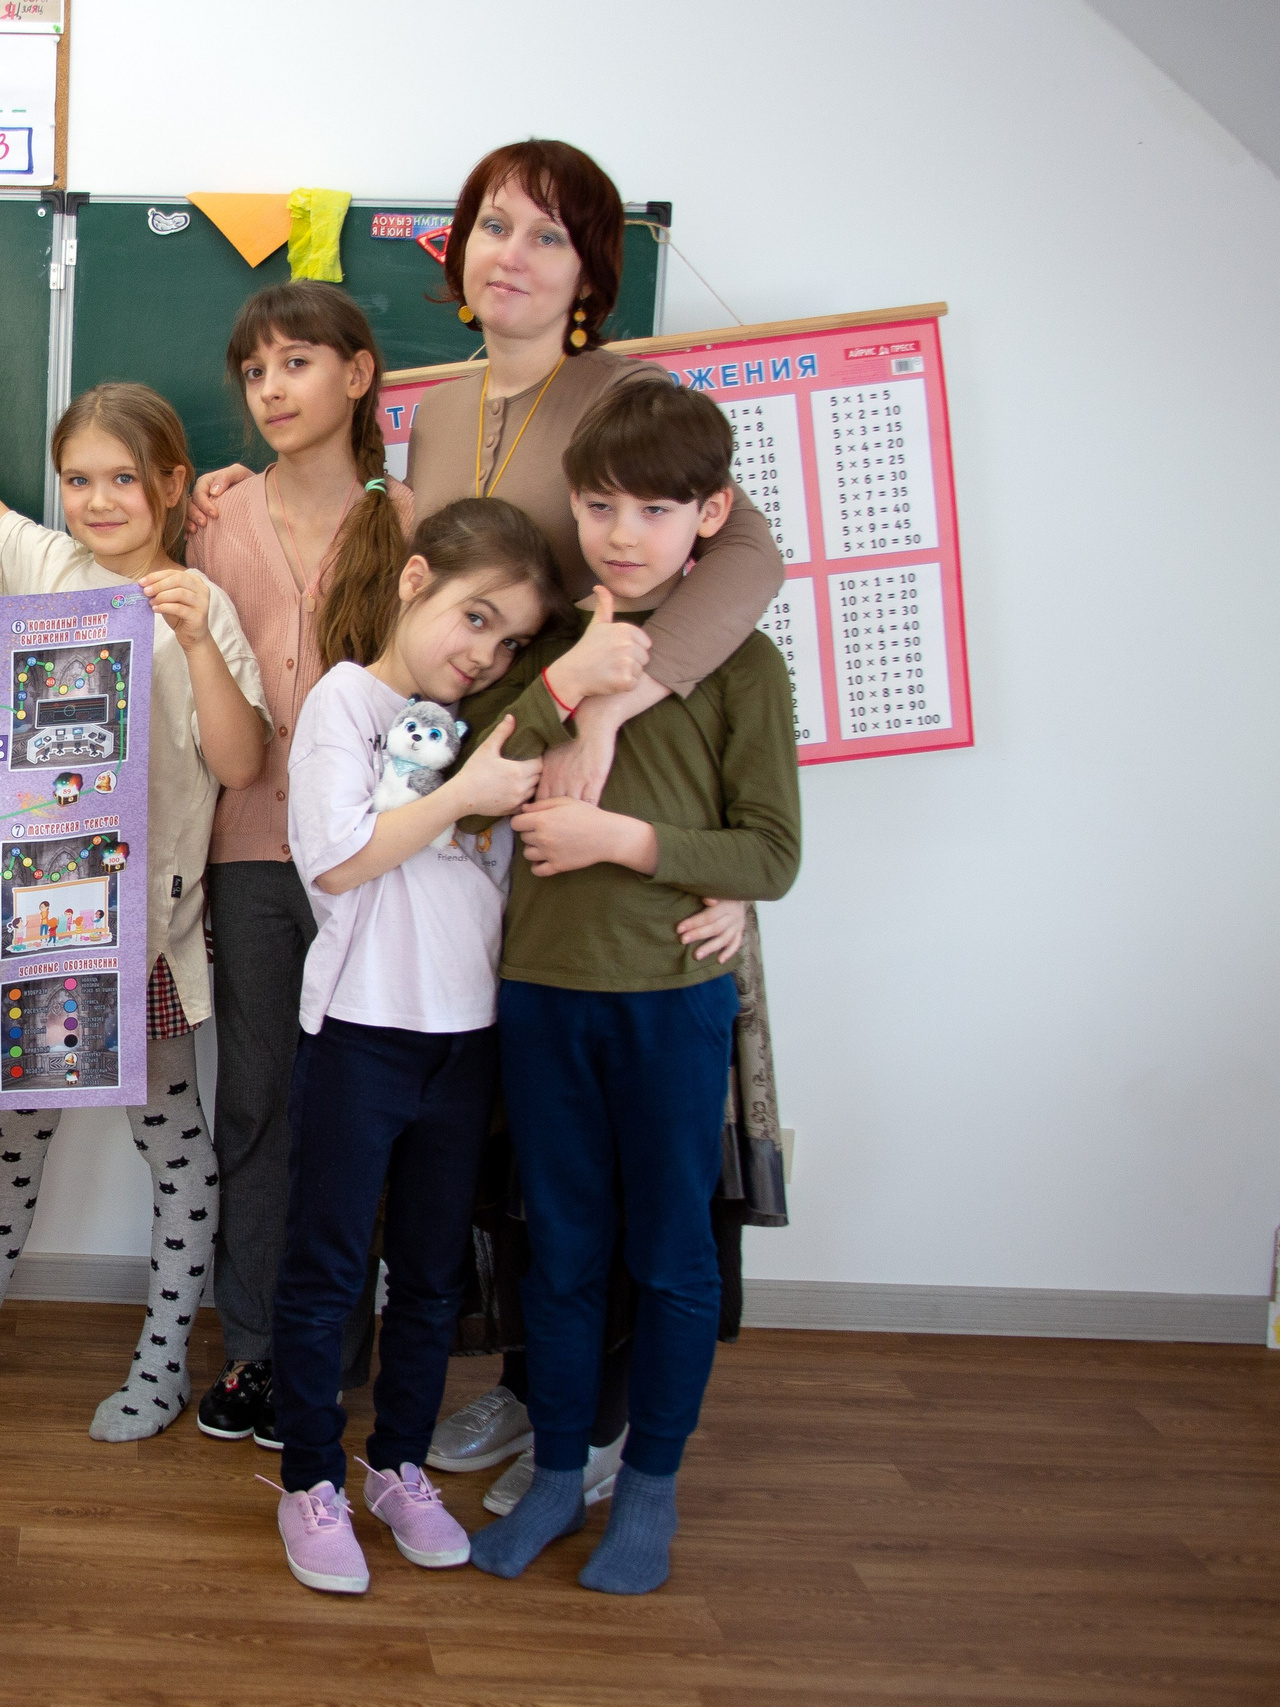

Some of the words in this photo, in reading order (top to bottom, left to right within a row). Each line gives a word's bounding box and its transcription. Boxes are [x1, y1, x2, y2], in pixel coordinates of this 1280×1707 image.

[890, 343, 916, 353] ПРЕСС
[830, 396, 838, 407] 5
[857, 393, 864, 403] 1
[883, 390, 890, 400] 5
[832, 412, 840, 423] 5
[858, 409, 866, 420] 2
[884, 405, 901, 416] 10
[835, 444, 843, 456] 5
[861, 442, 869, 452] 4
[887, 437, 904, 449] 20
[844, 542, 852, 552] 5
[870, 538, 886, 549] 10
[905, 534, 921, 545] 50
[839, 580, 856, 591] 10
[874, 577, 881, 587] 1
[900, 572, 916, 584] 10
[844, 643, 860, 654] 10
[878, 640, 886, 650] 5
[904, 636, 921, 648] 50
[851, 722, 867, 733] 10
[886, 718, 901, 729] 10
[917, 714, 940, 726] 100
[84, 815, 119, 830] ТЕКСТОВ
